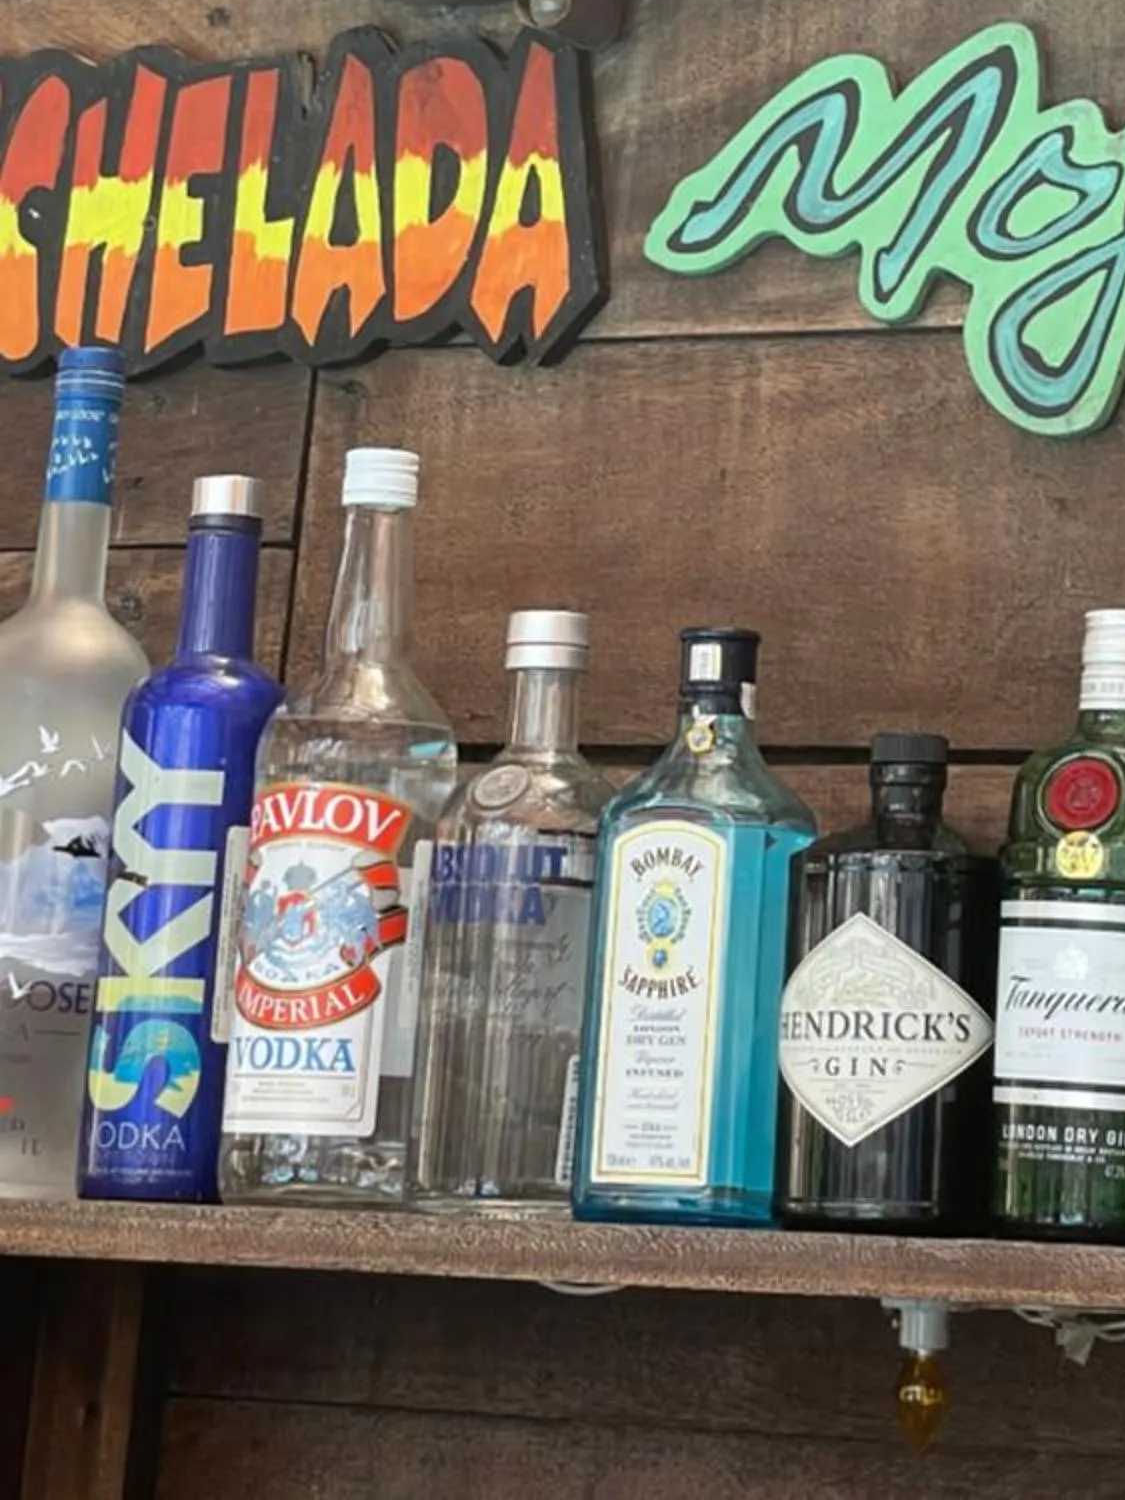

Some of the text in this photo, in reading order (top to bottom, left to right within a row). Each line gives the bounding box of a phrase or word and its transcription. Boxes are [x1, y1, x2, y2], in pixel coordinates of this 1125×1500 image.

[251, 788, 402, 843] PAVLOV
[631, 845, 704, 877] BOMBAY
[617, 964, 702, 1000] SAPPHIRE
[239, 982, 365, 1024] IMPERIAL
[781, 1010, 971, 1043] HENDRICK'S
[234, 1035, 356, 1073] VODKA
[825, 1056, 888, 1077] GIN
[92, 1120, 186, 1151] ODKA
[1063, 1125, 1099, 1143] DRY
